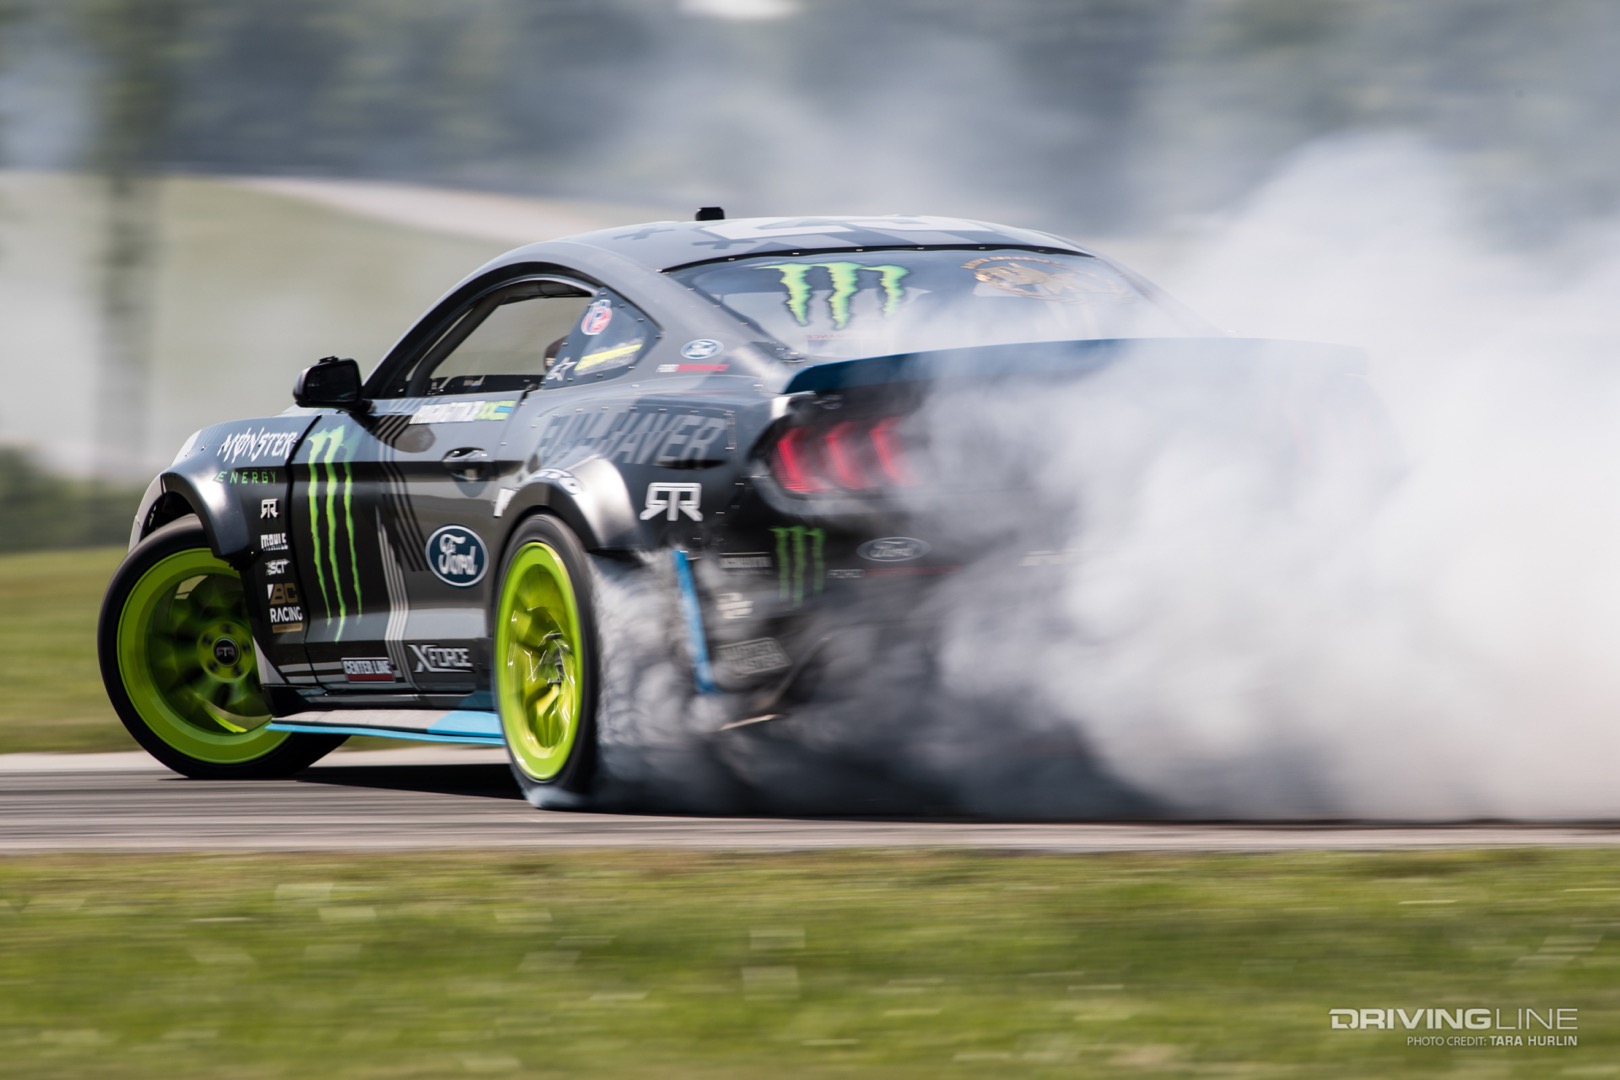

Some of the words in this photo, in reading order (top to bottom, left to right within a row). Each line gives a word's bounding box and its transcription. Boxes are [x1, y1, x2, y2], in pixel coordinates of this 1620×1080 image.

[213, 470, 278, 485] ENERGY
[437, 534, 478, 578] Ford
[269, 606, 304, 623] RACING
[343, 659, 374, 675] CENTER
